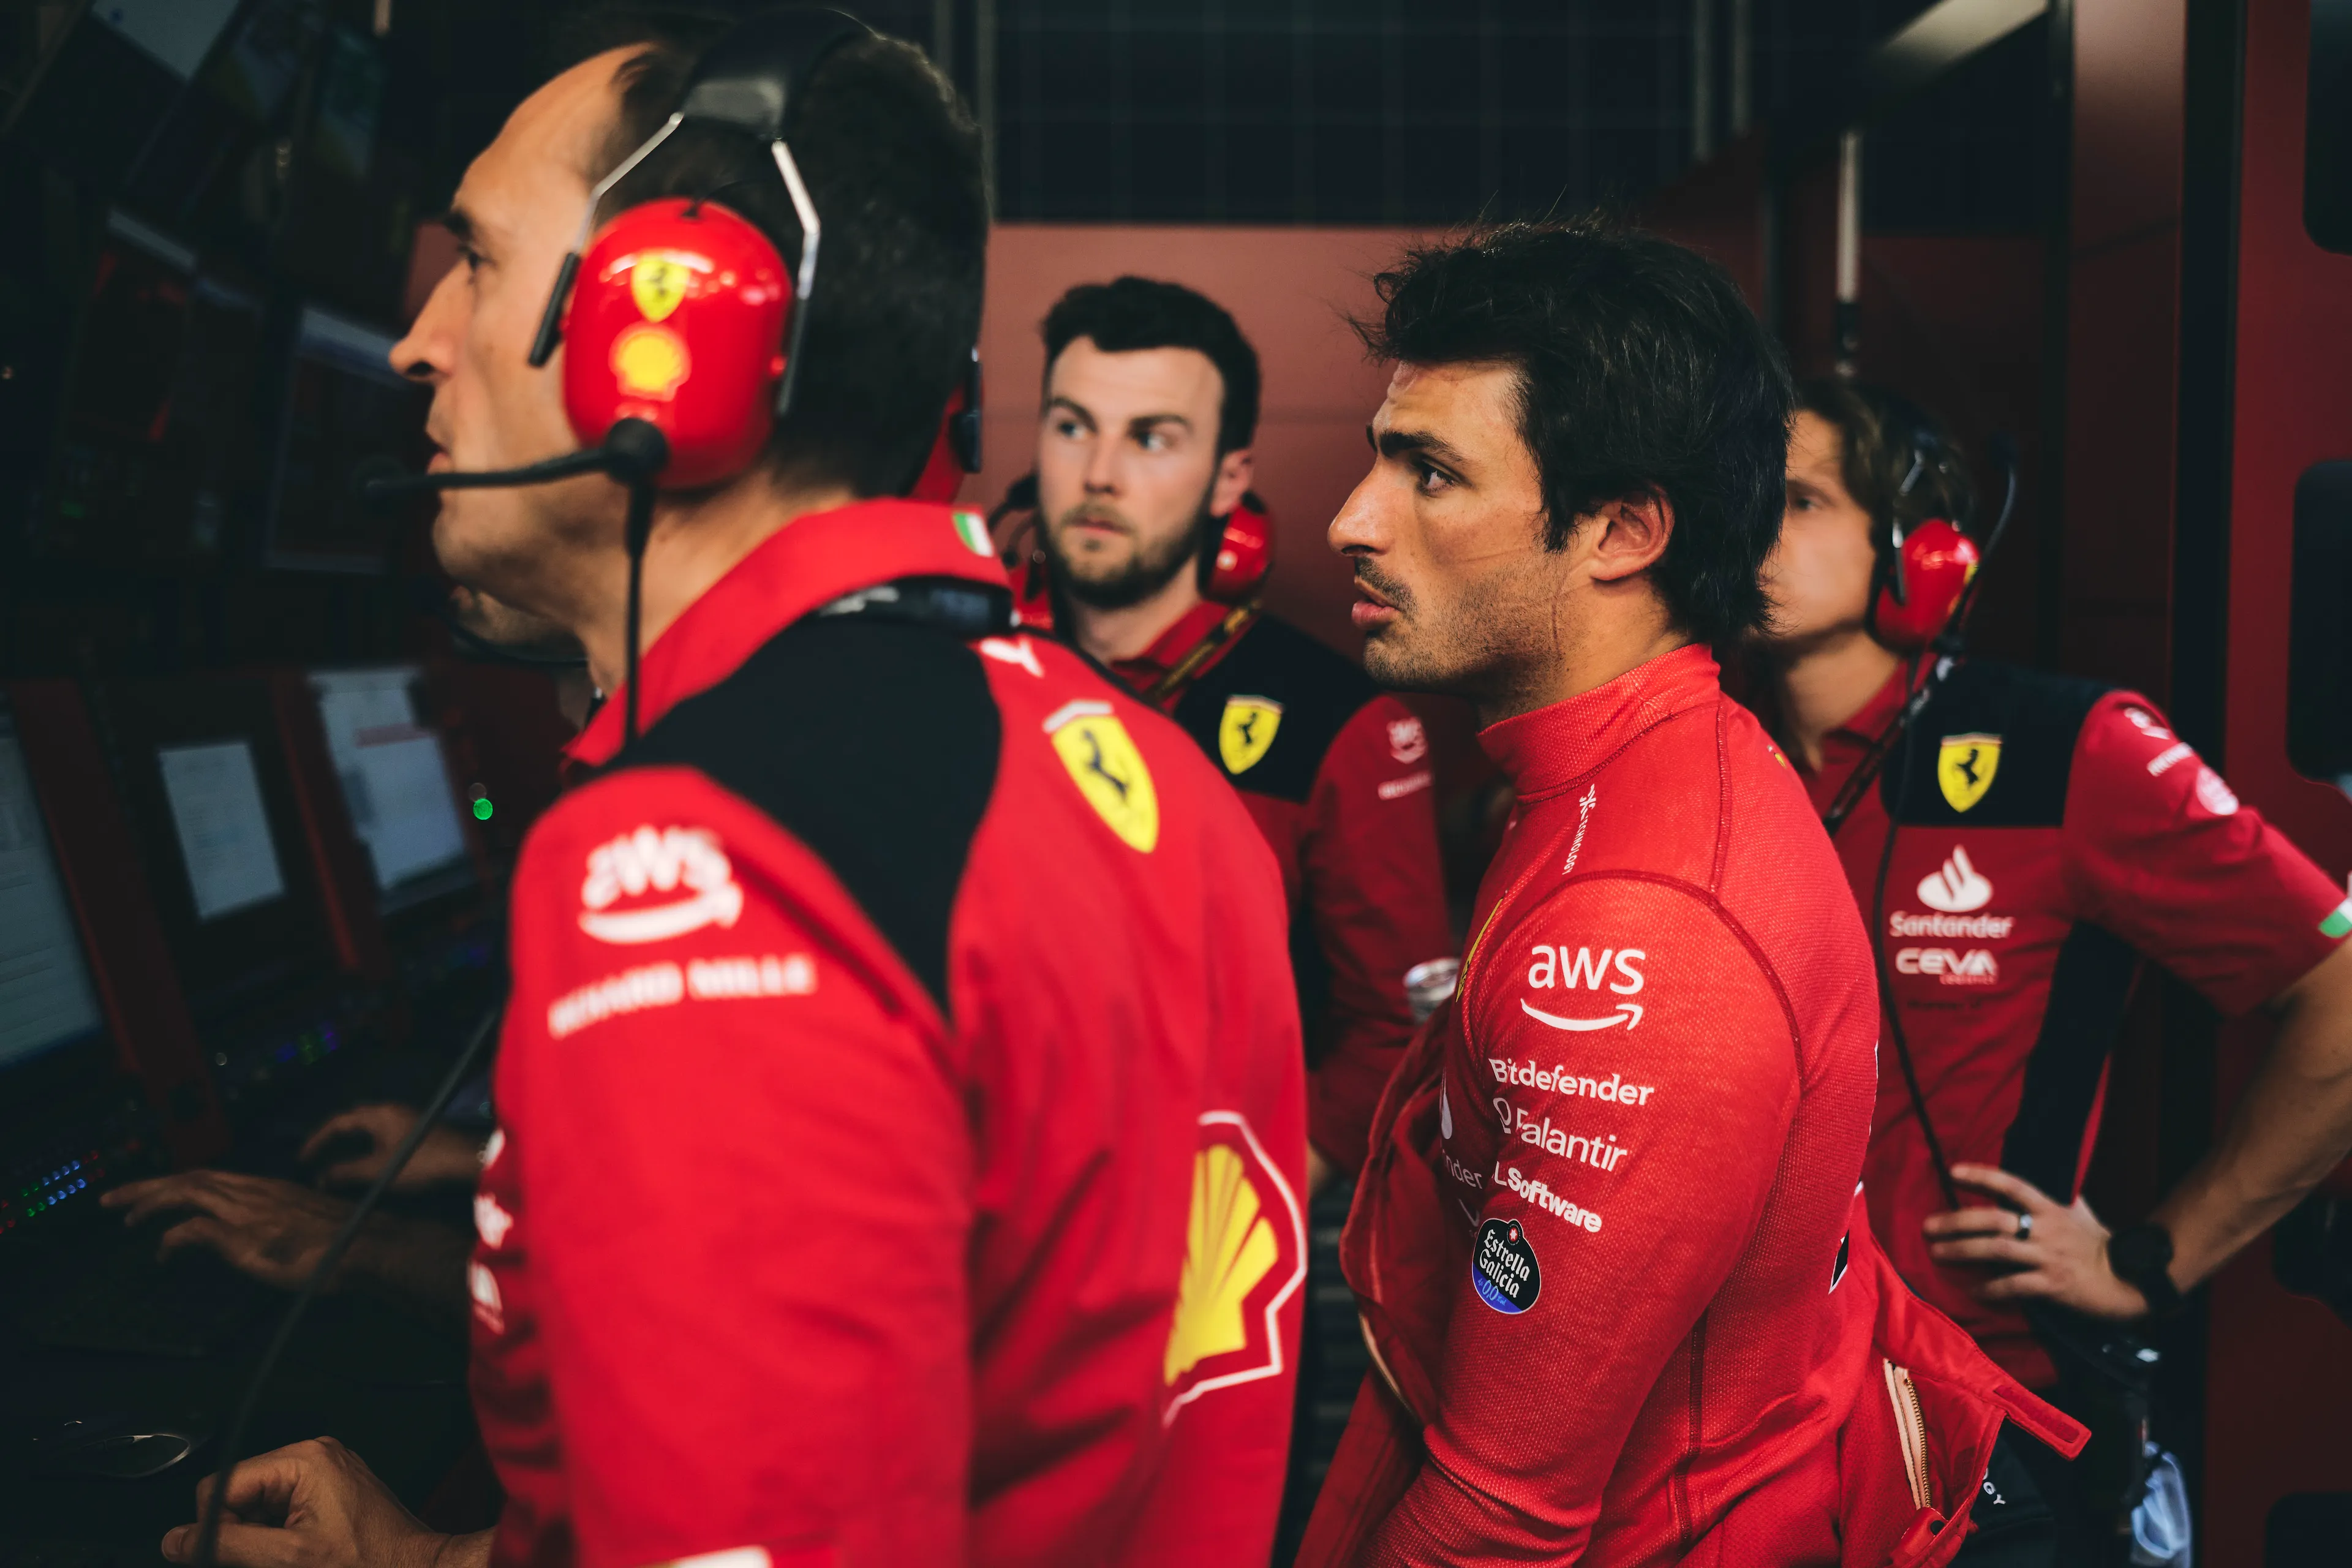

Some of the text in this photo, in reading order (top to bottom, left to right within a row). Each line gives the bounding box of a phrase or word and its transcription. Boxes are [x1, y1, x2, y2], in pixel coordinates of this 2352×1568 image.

[1890, 910, 2015, 938] Santander
[1528, 945, 1646, 995] aws
[1896, 947, 1998, 976] CEVA
[1488, 1057, 1654, 1106] Bitdefender
[1442, 1149, 1483, 1189] nder
[1491, 1161, 1602, 1233] LSoftware
[1479, 1248, 1520, 1298] Galicia
[1483, 1229, 1530, 1281] Estrella
